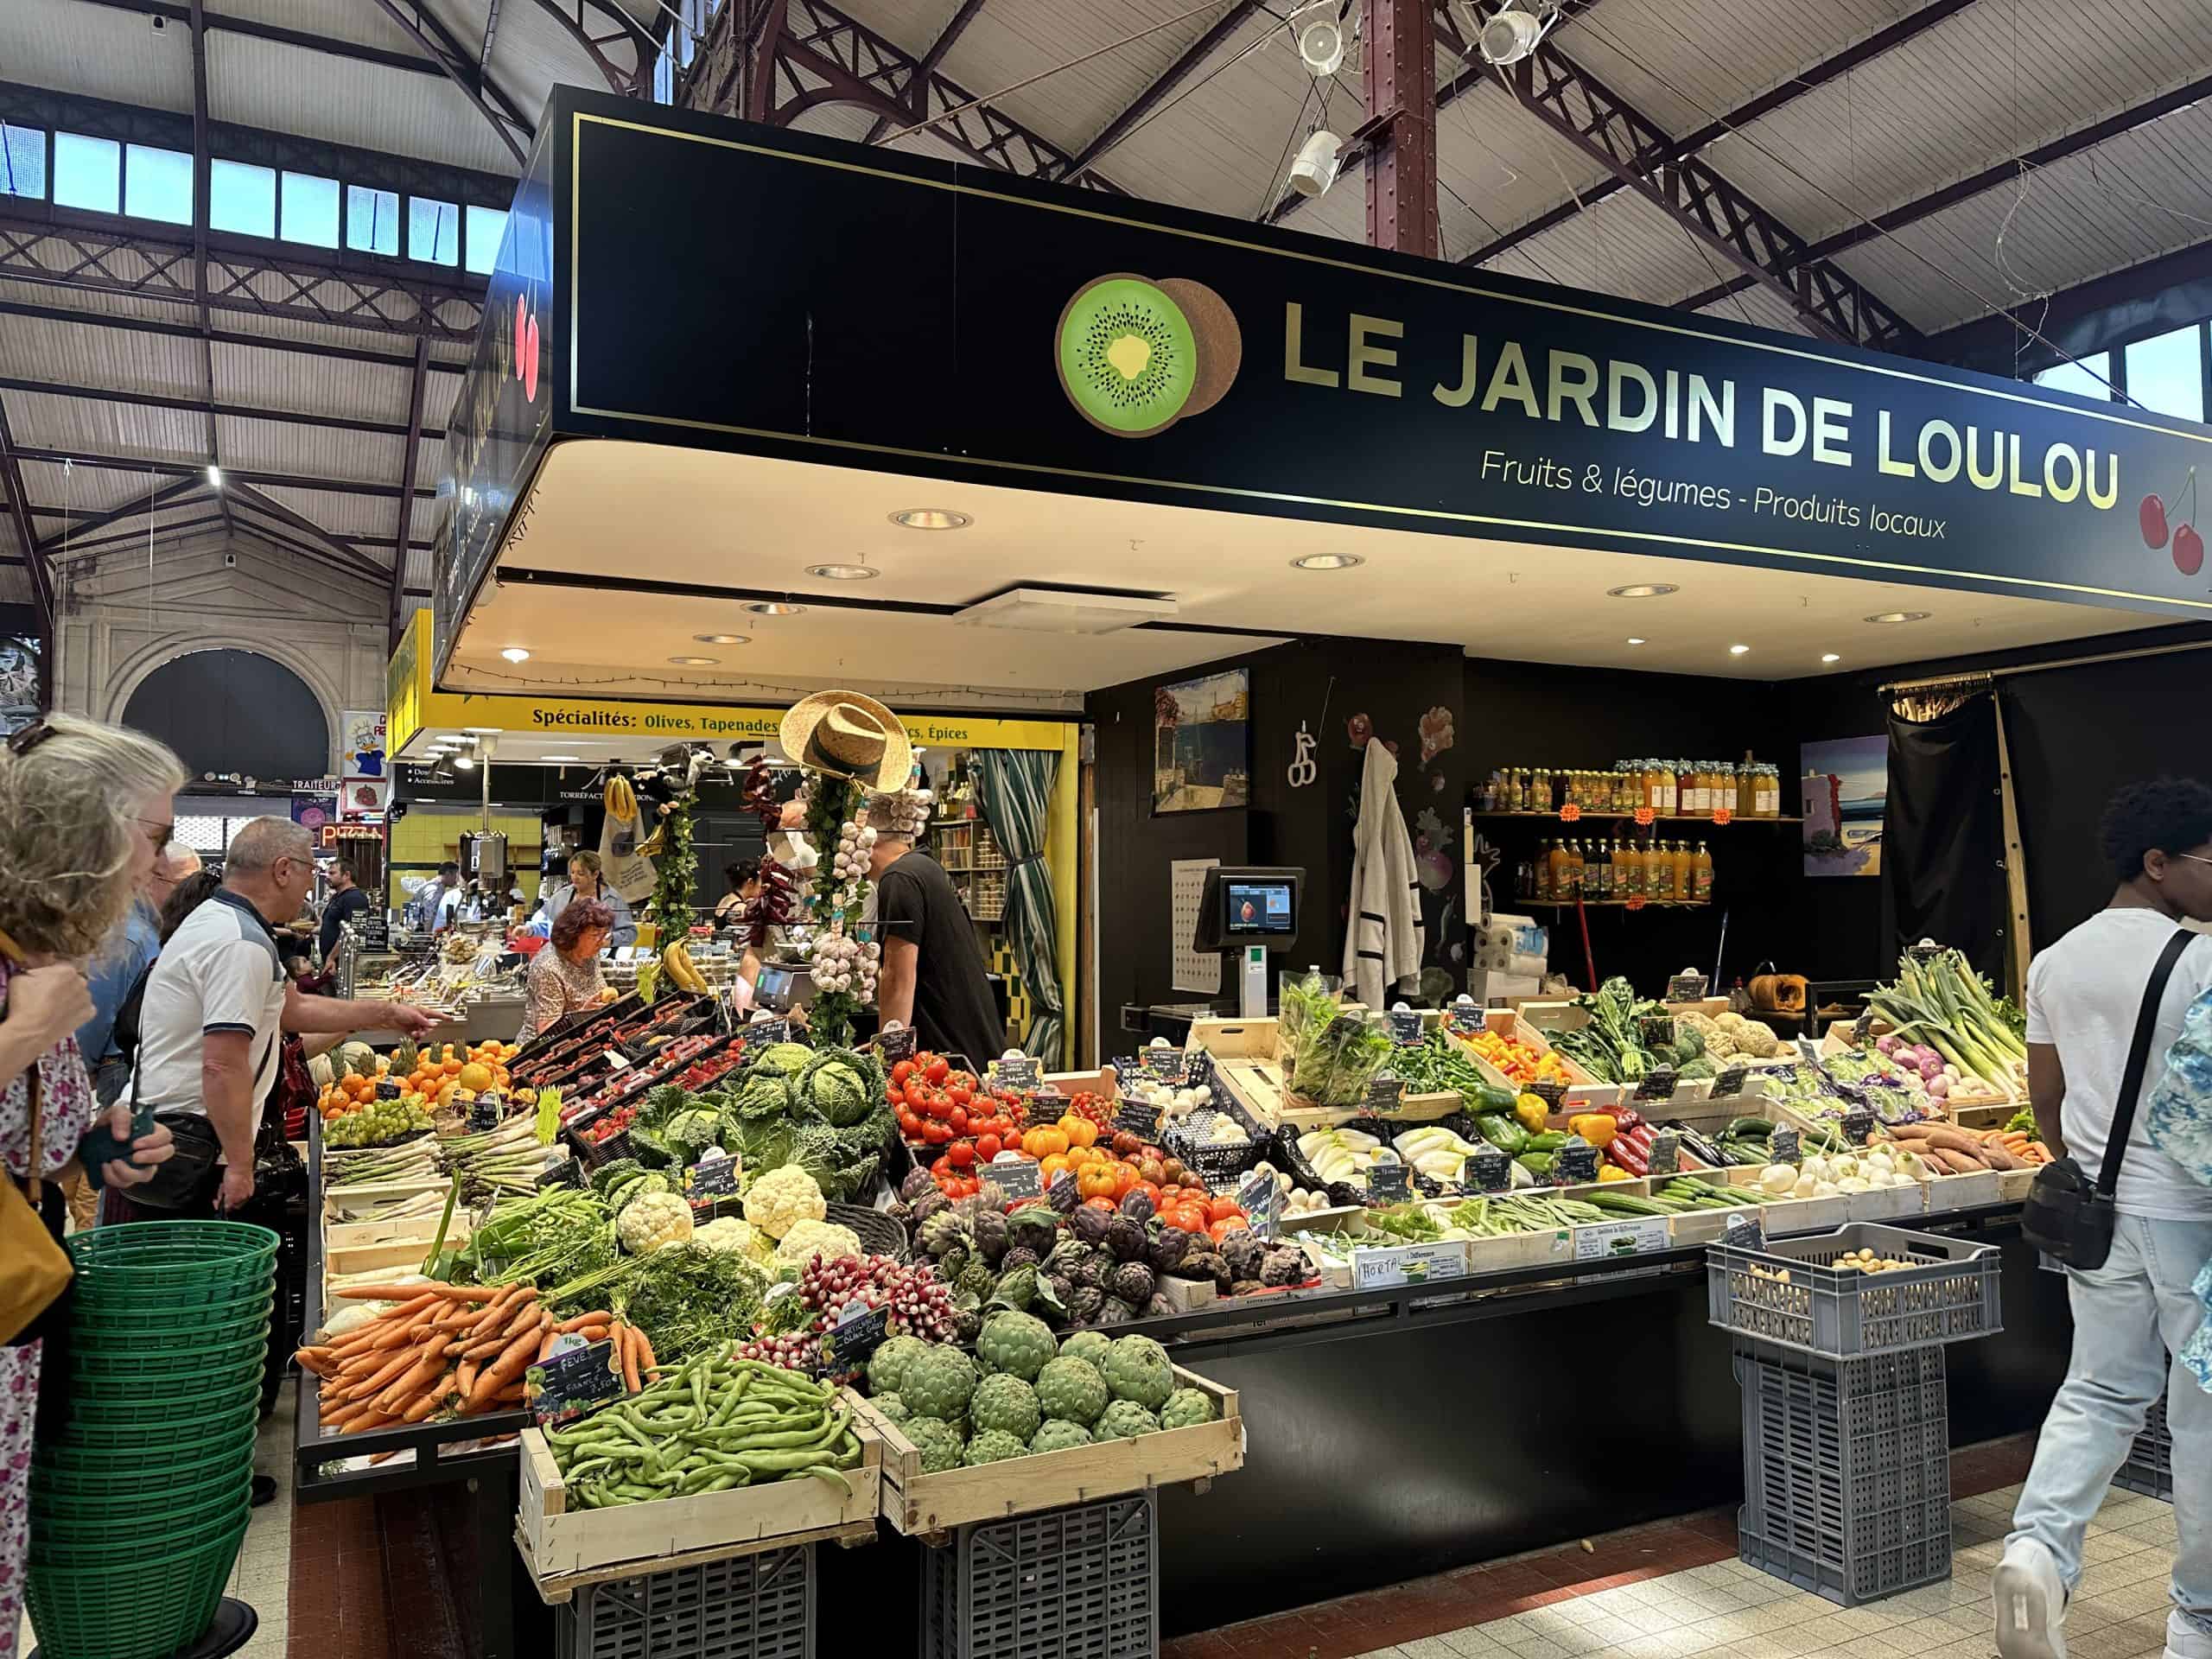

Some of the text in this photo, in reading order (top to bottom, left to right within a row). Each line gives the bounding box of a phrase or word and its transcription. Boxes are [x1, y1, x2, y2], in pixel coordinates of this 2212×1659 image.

[1284, 301, 2118, 510] LE JARDIN DE LOULOU
[1481, 449, 1573, 490] Fruits
[1581, 463, 1603, 494] &
[1613, 466, 1732, 510] légumes
[1754, 486, 1860, 527] Produits
[1869, 504, 1947, 539] locaux
[533, 709, 637, 728] Spécialités:
[645, 715, 695, 730] Olives,
[700, 717, 778, 734] Tapenades
[929, 724, 968, 741] Épices
[293, 780, 336, 791] TRAITEUR
